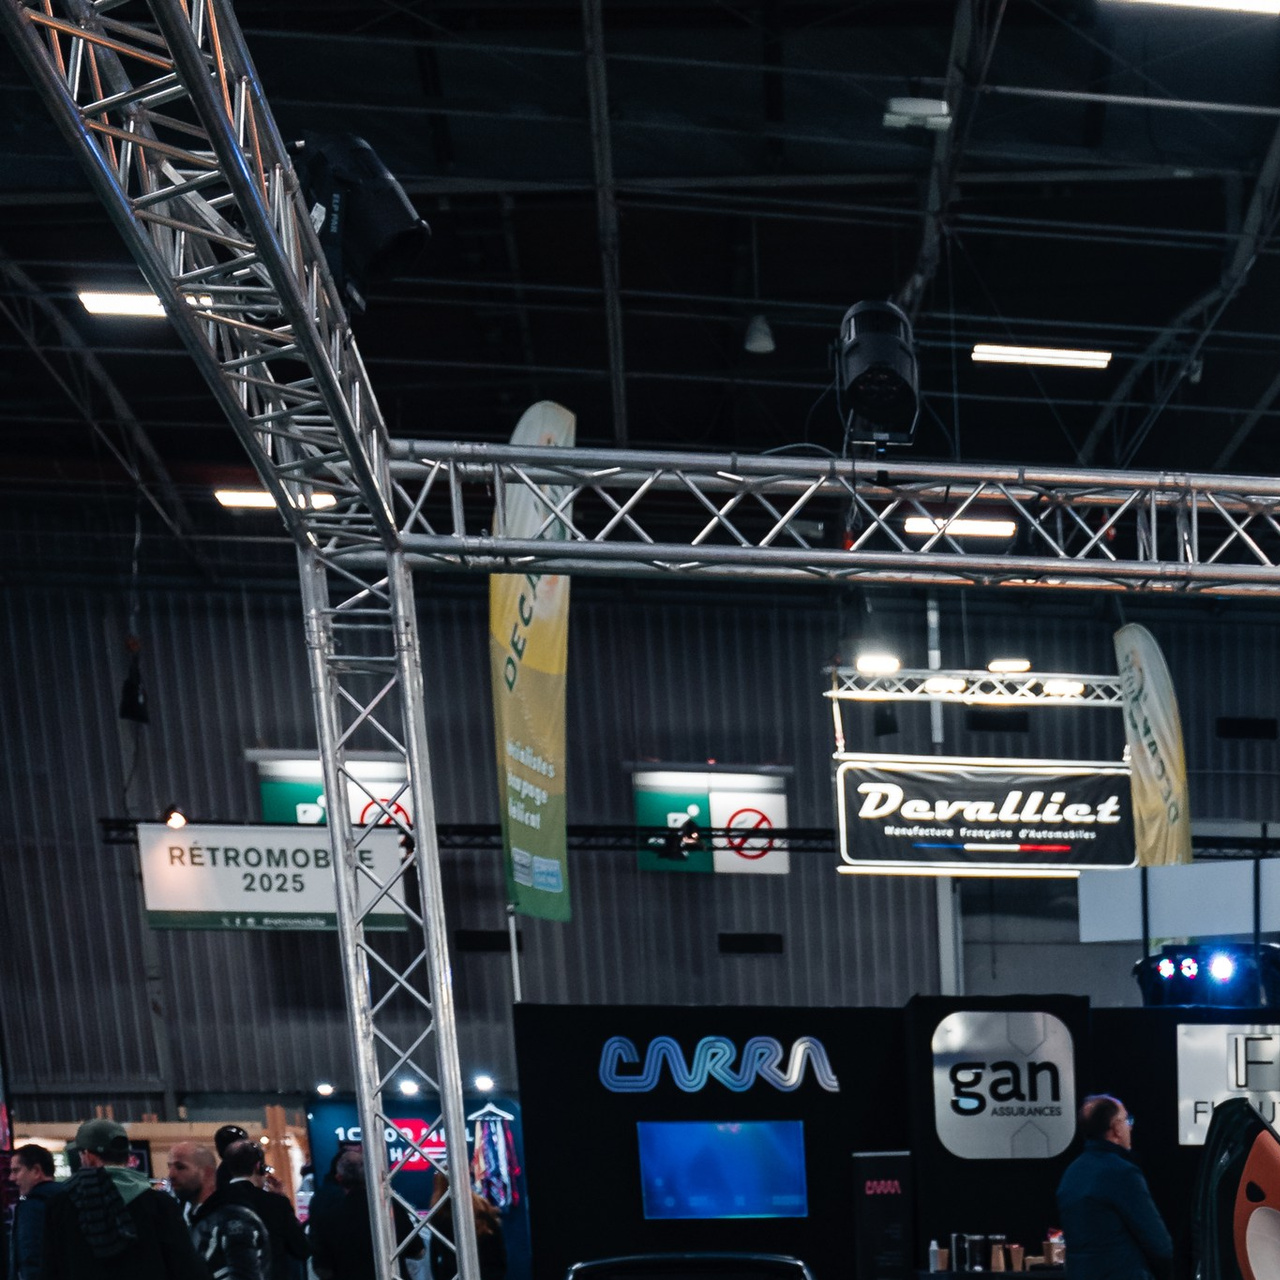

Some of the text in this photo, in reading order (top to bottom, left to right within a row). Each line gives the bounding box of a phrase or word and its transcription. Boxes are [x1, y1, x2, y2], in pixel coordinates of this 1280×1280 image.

[857, 782, 1121, 824] Devalliet
[168, 841, 375, 869] RÉTROMOBE
[242, 873, 306, 893] 2025
[949, 1059, 1061, 1117] gan
[990, 1105, 1063, 1117] ASSURANCES
